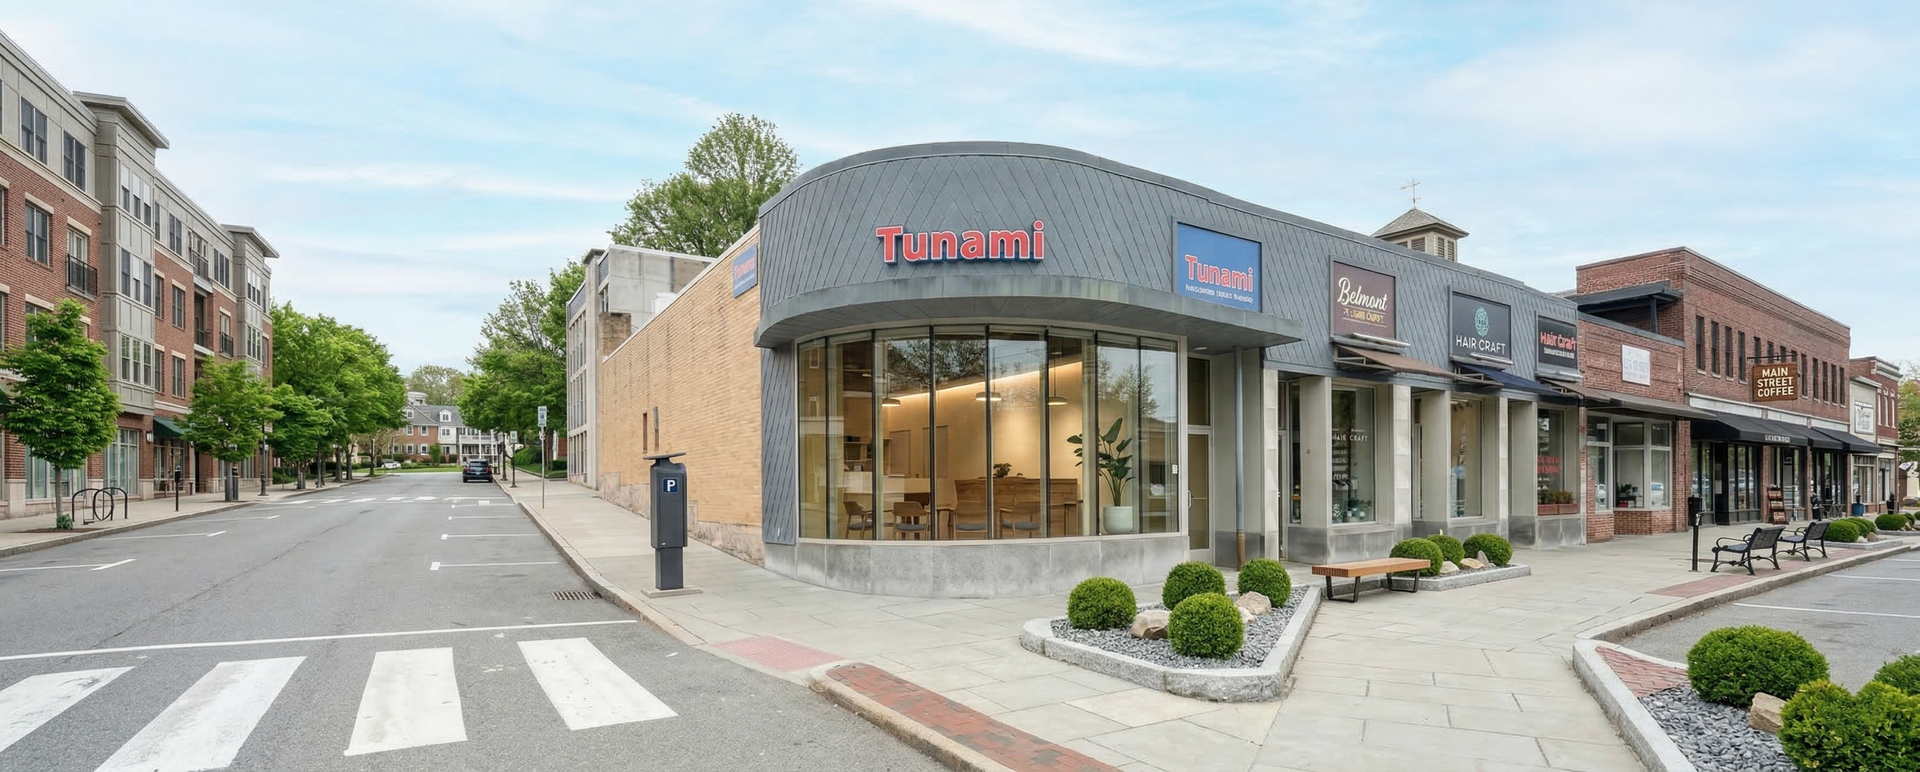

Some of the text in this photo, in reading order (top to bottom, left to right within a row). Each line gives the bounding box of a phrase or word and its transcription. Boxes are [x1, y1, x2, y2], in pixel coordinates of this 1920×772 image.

[876, 220, 1045, 264] Tunami
[1185, 254, 1254, 292] Tunami
[1337, 277, 1388, 311] Belmont
[1455, 334, 1506, 355] HAIR CRAFT
[1762, 367, 1788, 378] MAIN
[1757, 376, 1794, 388] STREET
[1757, 386, 1795, 398] COFFEE
[666, 479, 676, 492] P
